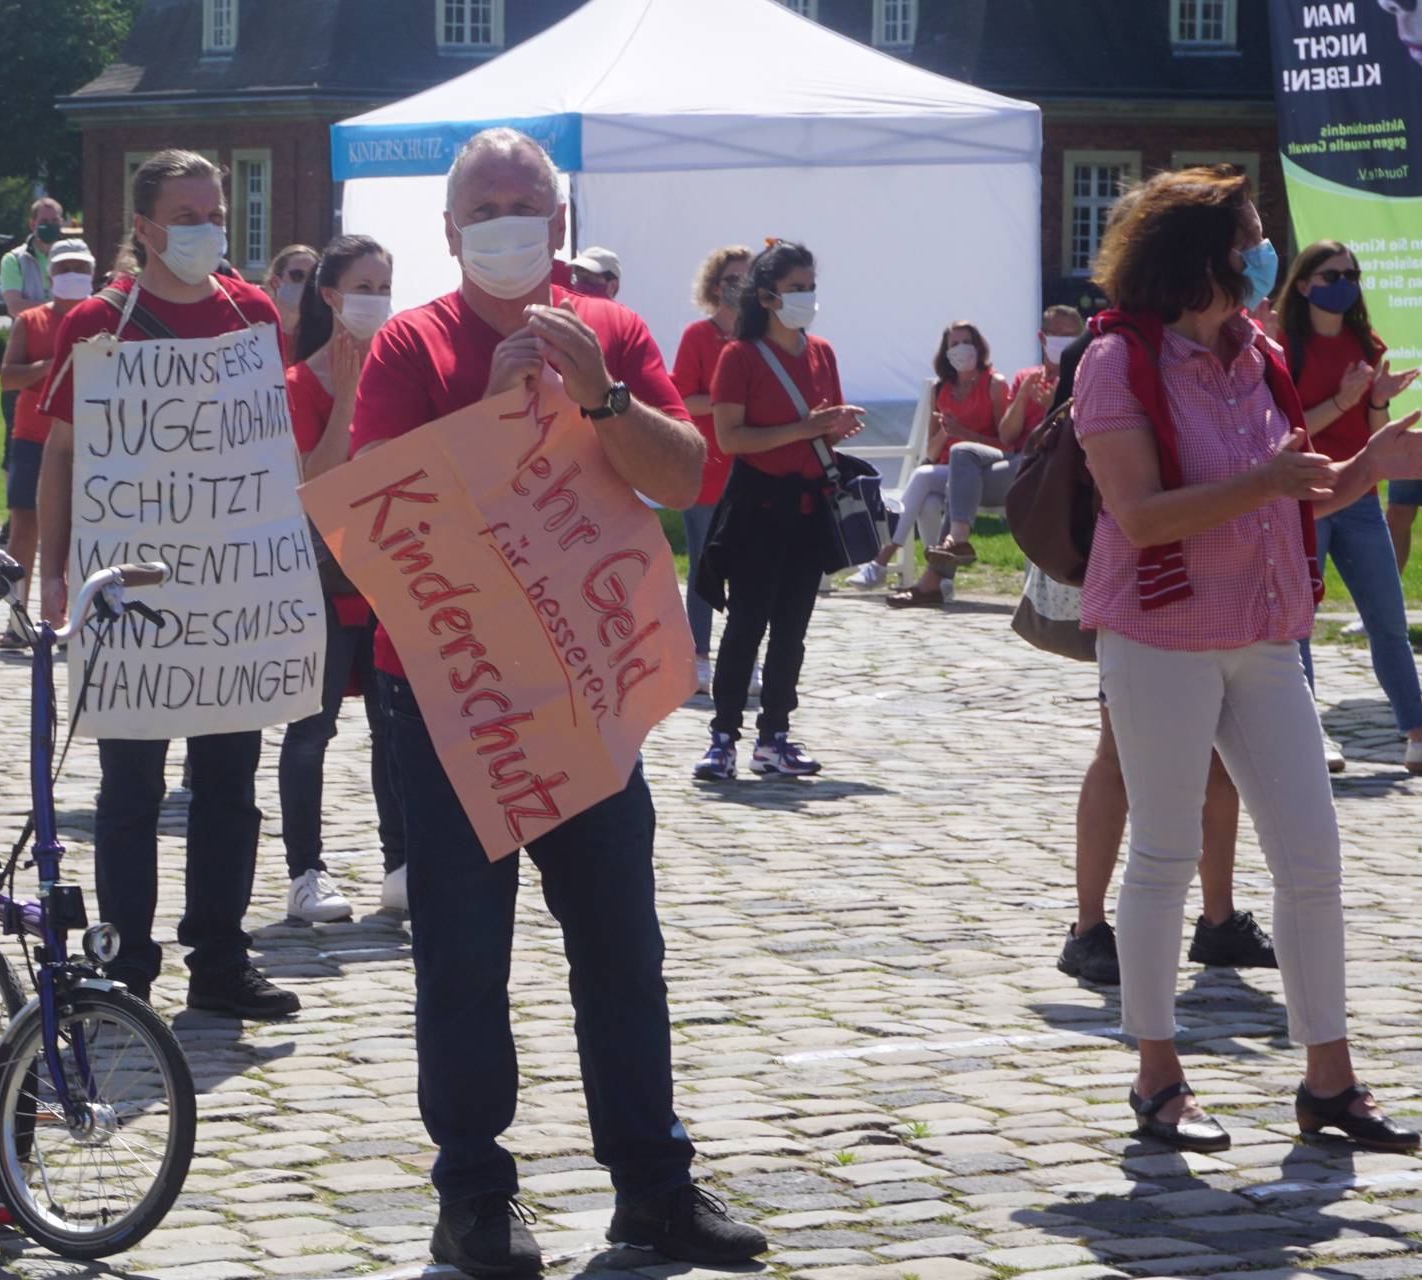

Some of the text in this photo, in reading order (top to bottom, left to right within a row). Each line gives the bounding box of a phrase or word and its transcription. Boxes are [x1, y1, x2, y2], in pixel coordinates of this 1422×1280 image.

[348, 137, 442, 163] KINDERSCHUTZ
[84, 384, 289, 458] JUGENDAMT
[81, 469, 270, 526] SCHÜTZT
[498, 390, 662, 718] Mehr Geld
[349, 469, 571, 844] Kinderschutz
[478, 521, 608, 729] für besseren
[82, 651, 317, 713] HANDLUNGEN
